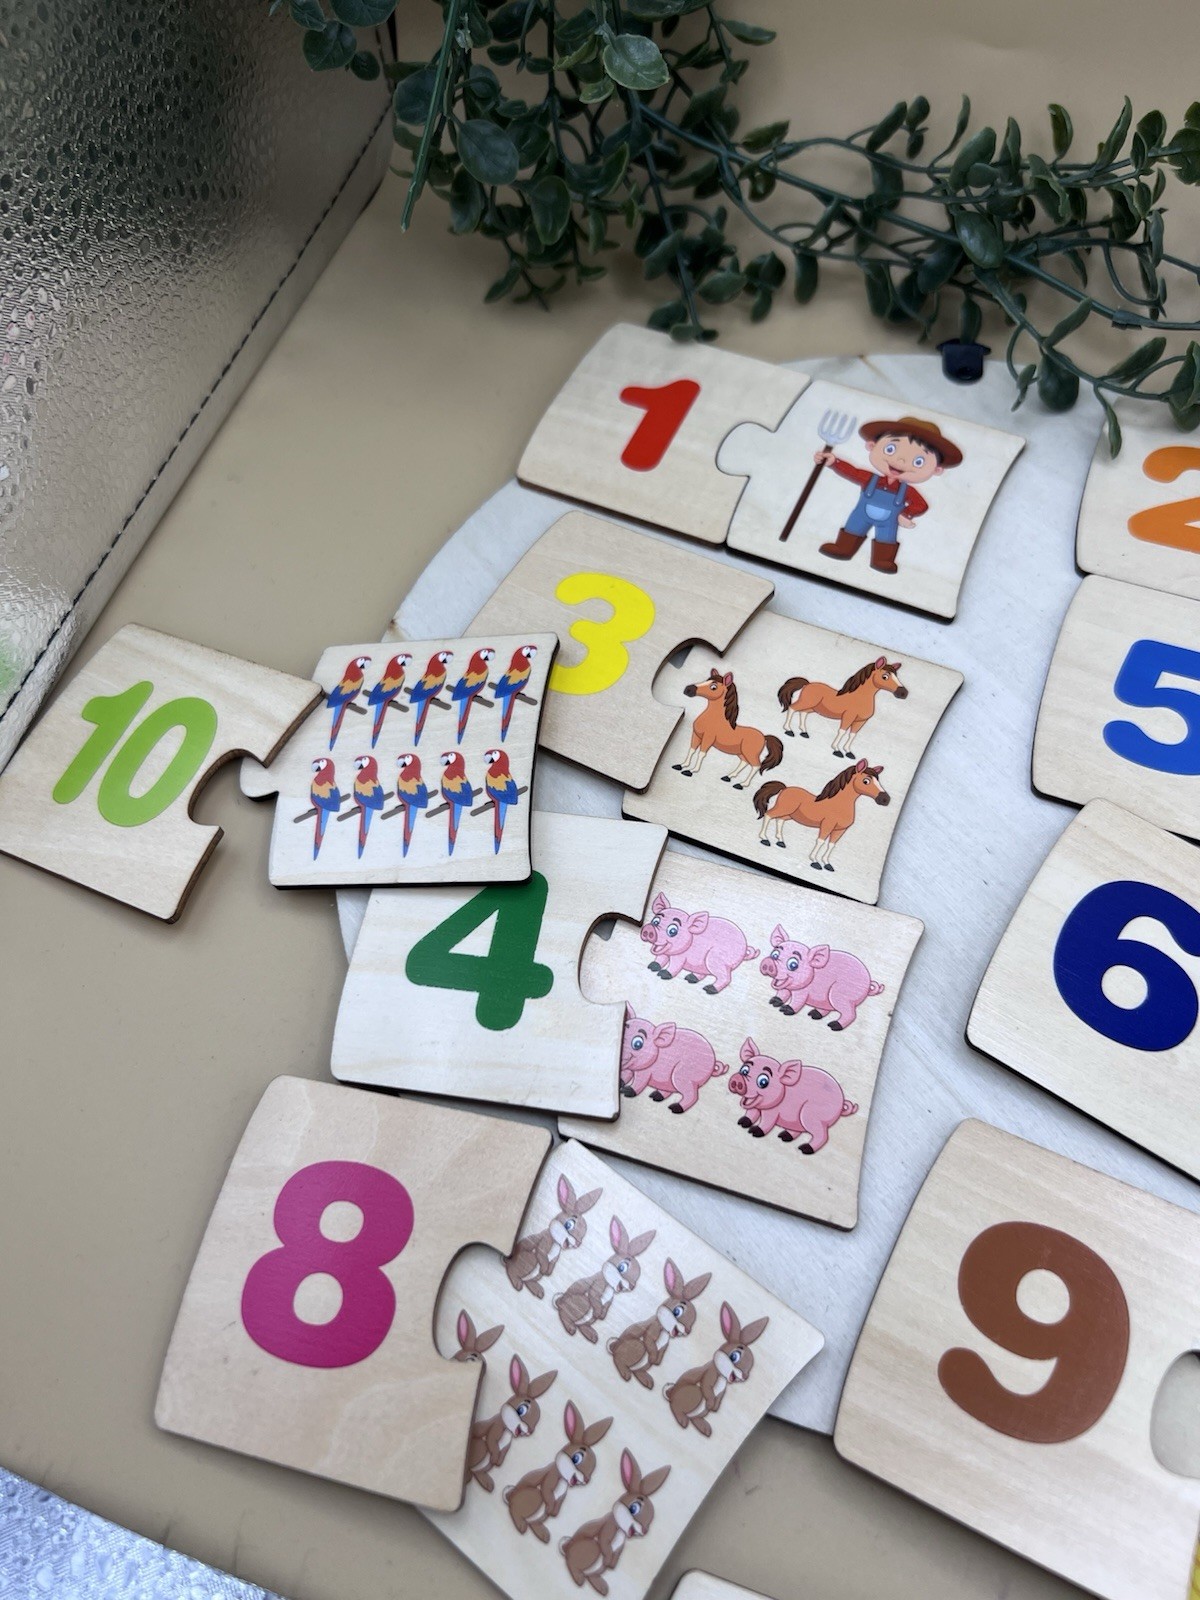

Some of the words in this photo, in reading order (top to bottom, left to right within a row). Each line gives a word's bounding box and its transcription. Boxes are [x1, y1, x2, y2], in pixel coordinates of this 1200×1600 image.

[619, 379, 701, 472] 1
[1127, 446, 1200, 554] 2
[548, 572, 656, 696] 3
[1103, 639, 1200, 775] 5
[52, 681, 218, 827] 10
[405, 870, 554, 1031] 4
[1053, 880, 1200, 1052] 6
[241, 1160, 415, 1369] 8
[938, 1221, 1130, 1444] 9
